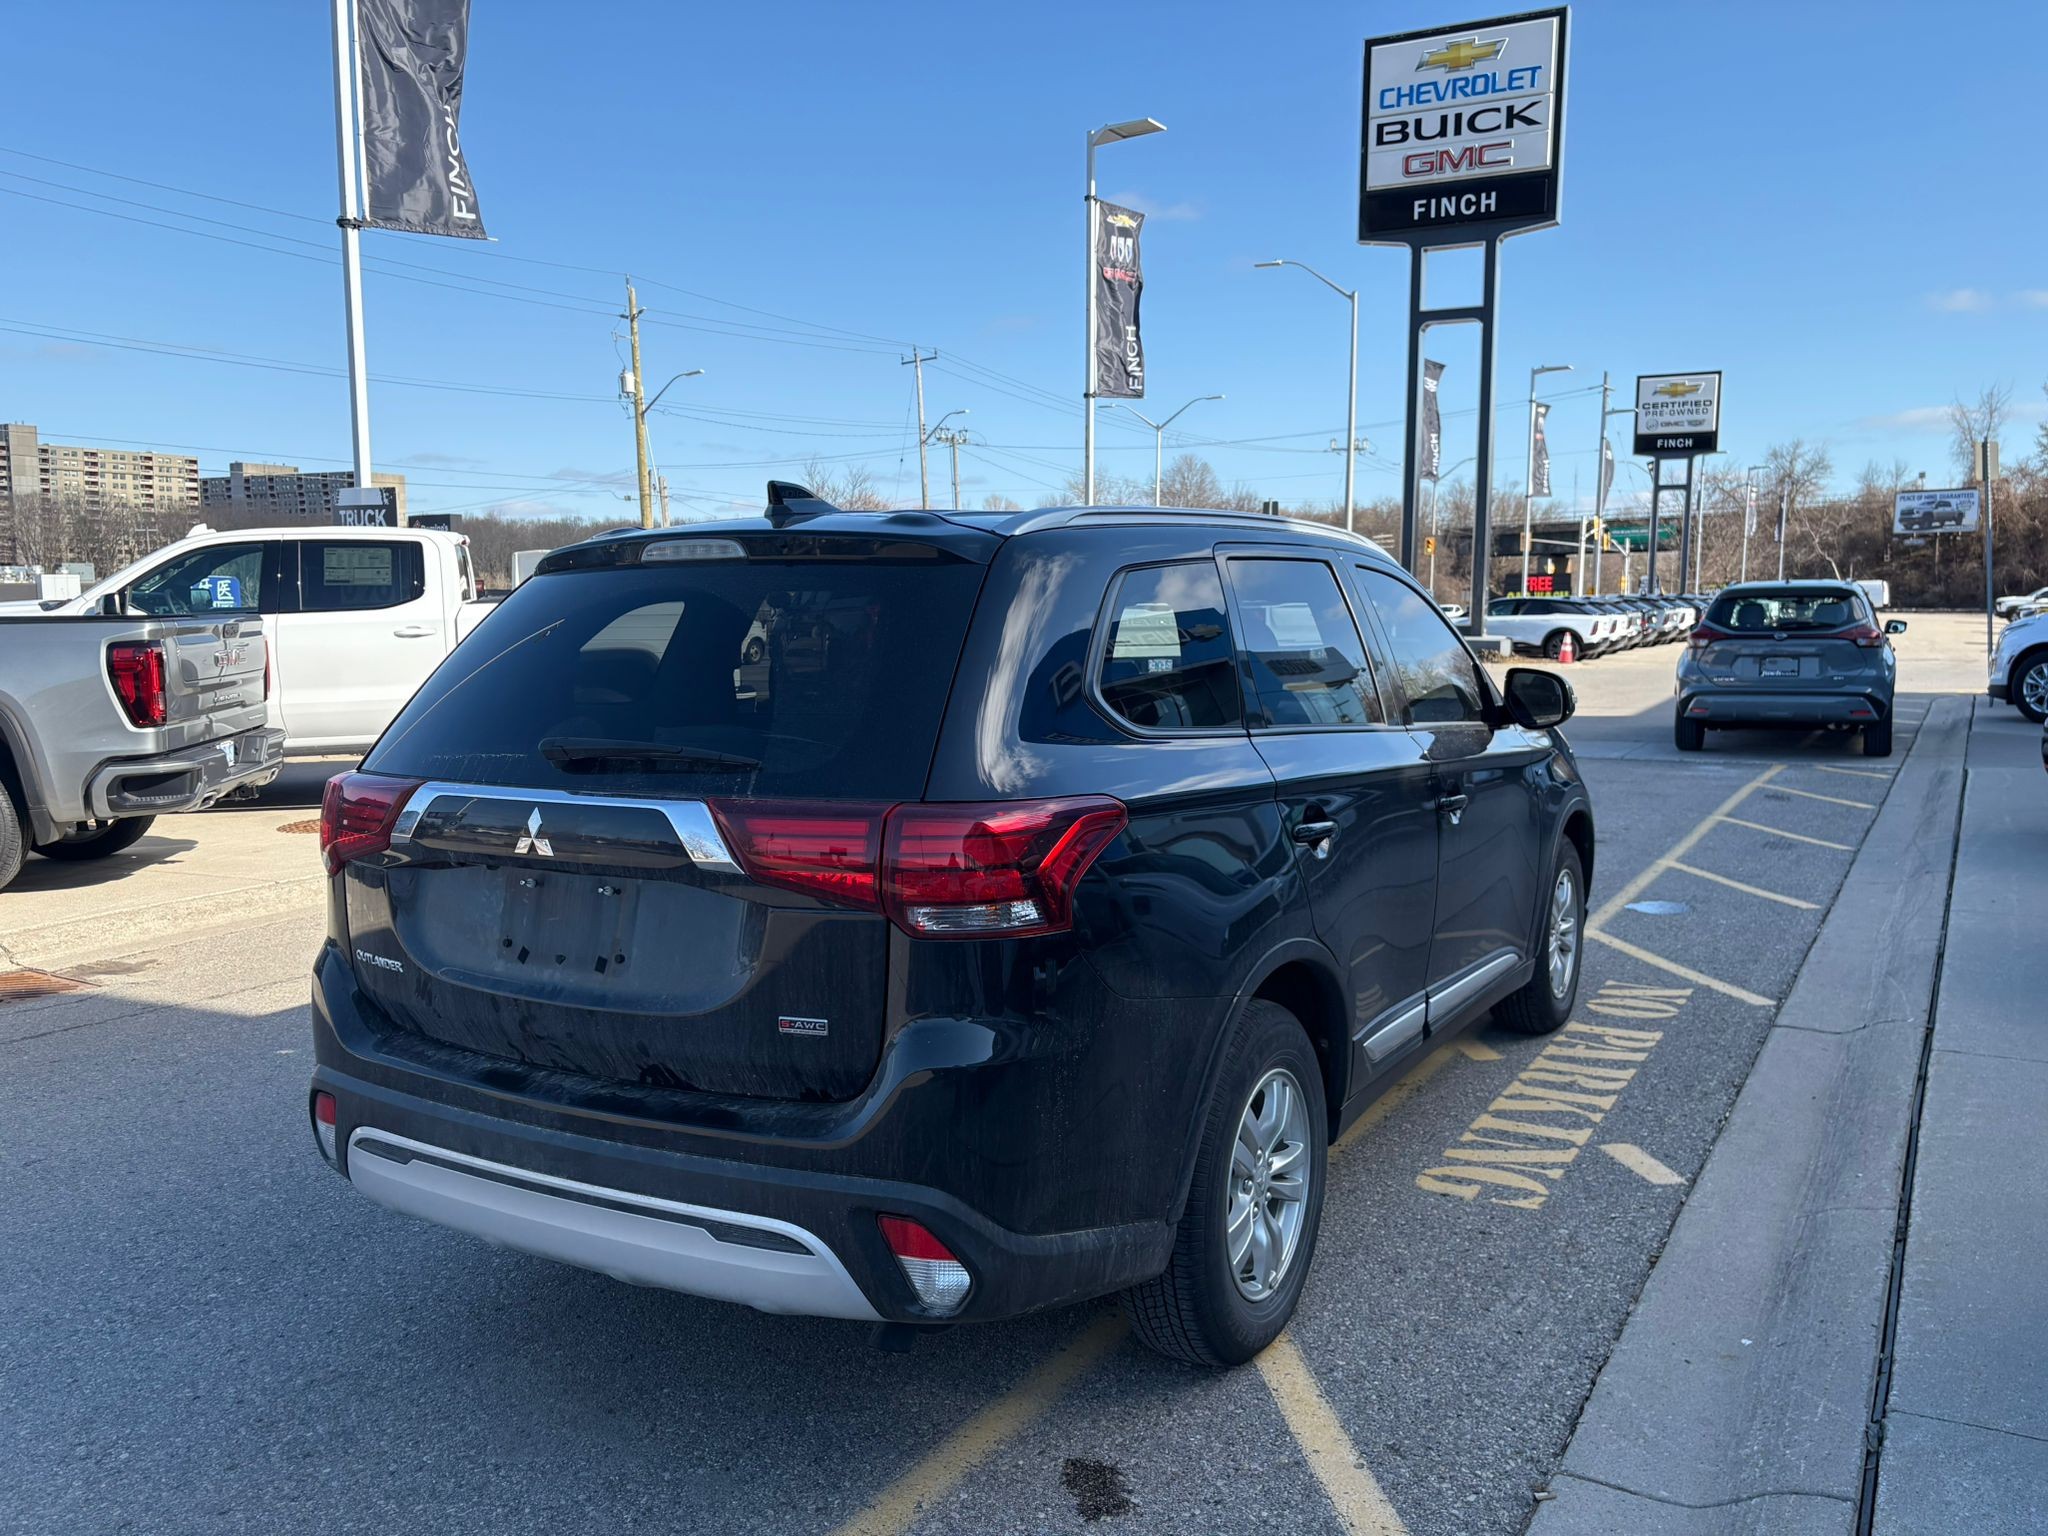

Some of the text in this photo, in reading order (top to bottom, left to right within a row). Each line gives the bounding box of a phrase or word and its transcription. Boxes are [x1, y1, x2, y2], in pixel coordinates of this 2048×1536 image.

[1379, 65, 1542, 110] CHEVROLET
[1376, 100, 1543, 147] BUICK
[1402, 138, 1514, 178] GMC
[1413, 191, 1497, 221] FINCH
[1125, 326, 1143, 390] FINCH
[1642, 399, 1713, 410] CERTIFIED
[1644, 407, 1709, 417] PRE-OWNED
[1656, 437, 1693, 448] FINCH
[338, 508, 387, 527] TRUCK
[1525, 576, 1553, 591] FREE
[213, 648, 248, 668] GMC
[356, 949, 404, 973] OUTLANDER
[781, 1020, 825, 1030] S-AWC
[1415, 979, 1694, 1210] NO PARKING
